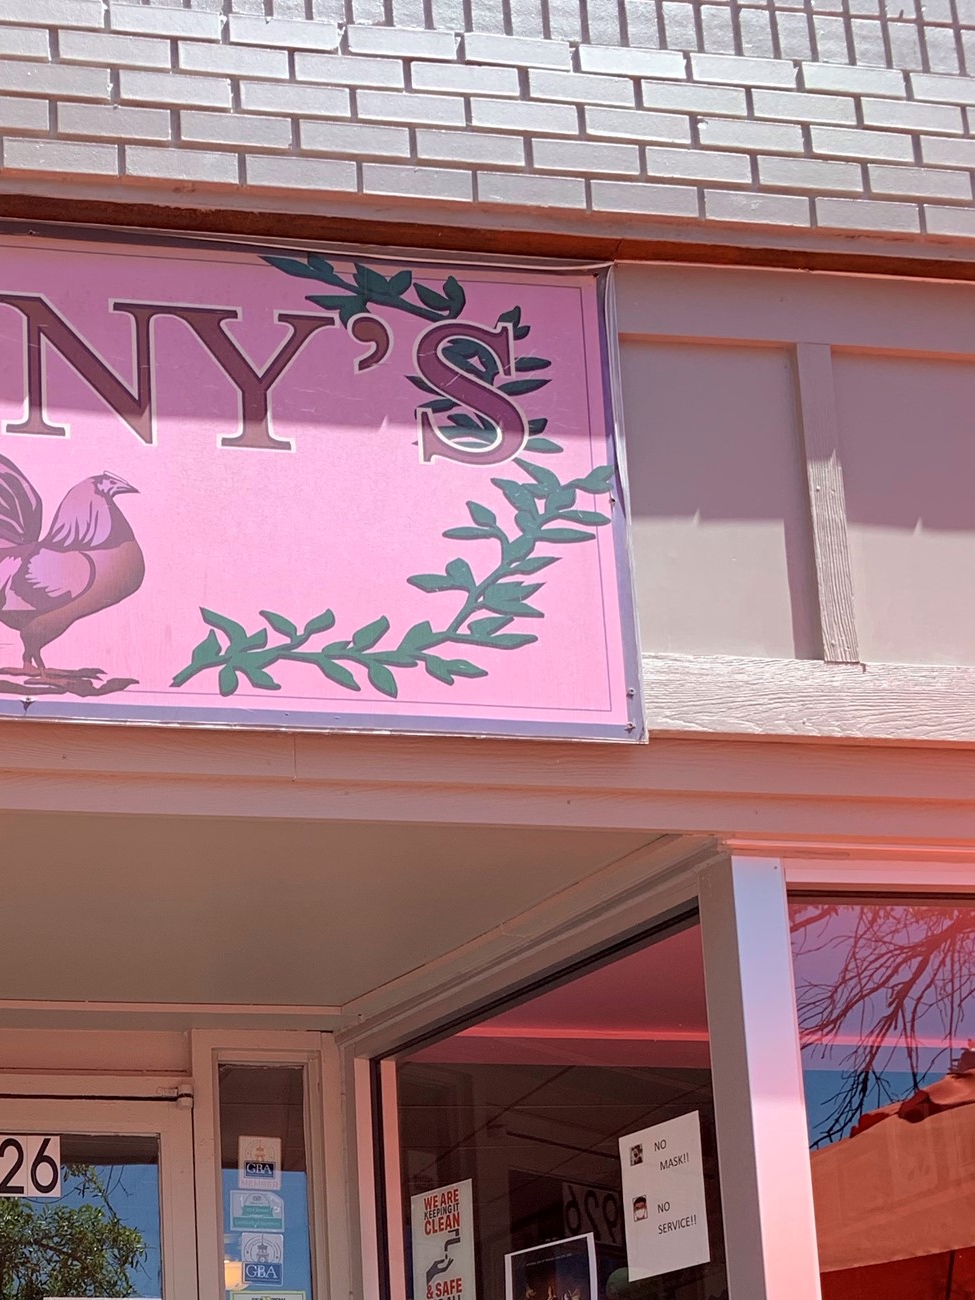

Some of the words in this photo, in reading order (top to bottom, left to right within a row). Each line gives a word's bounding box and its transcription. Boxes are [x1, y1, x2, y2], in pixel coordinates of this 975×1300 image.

[654, 1139, 667, 1151] NO
[246, 1163, 272, 1175] GBA
[659, 1152, 689, 1170] MASK!!
[241, 1180, 279, 1188] MEMBER
[423, 1194, 438, 1210] WE
[440, 1188, 459, 1206] ARE
[657, 1202, 671, 1214] NO
[424, 1205, 452, 1220] KEEPING
[453, 1202, 459, 1212] IT
[425, 1212, 461, 1236] CLEAN
[657, 1214, 697, 1235] SERVICE!!
[245, 1264, 278, 1278] GBA
[427, 1284, 433, 1300] &
[435, 1278, 463, 1298] SAFE
